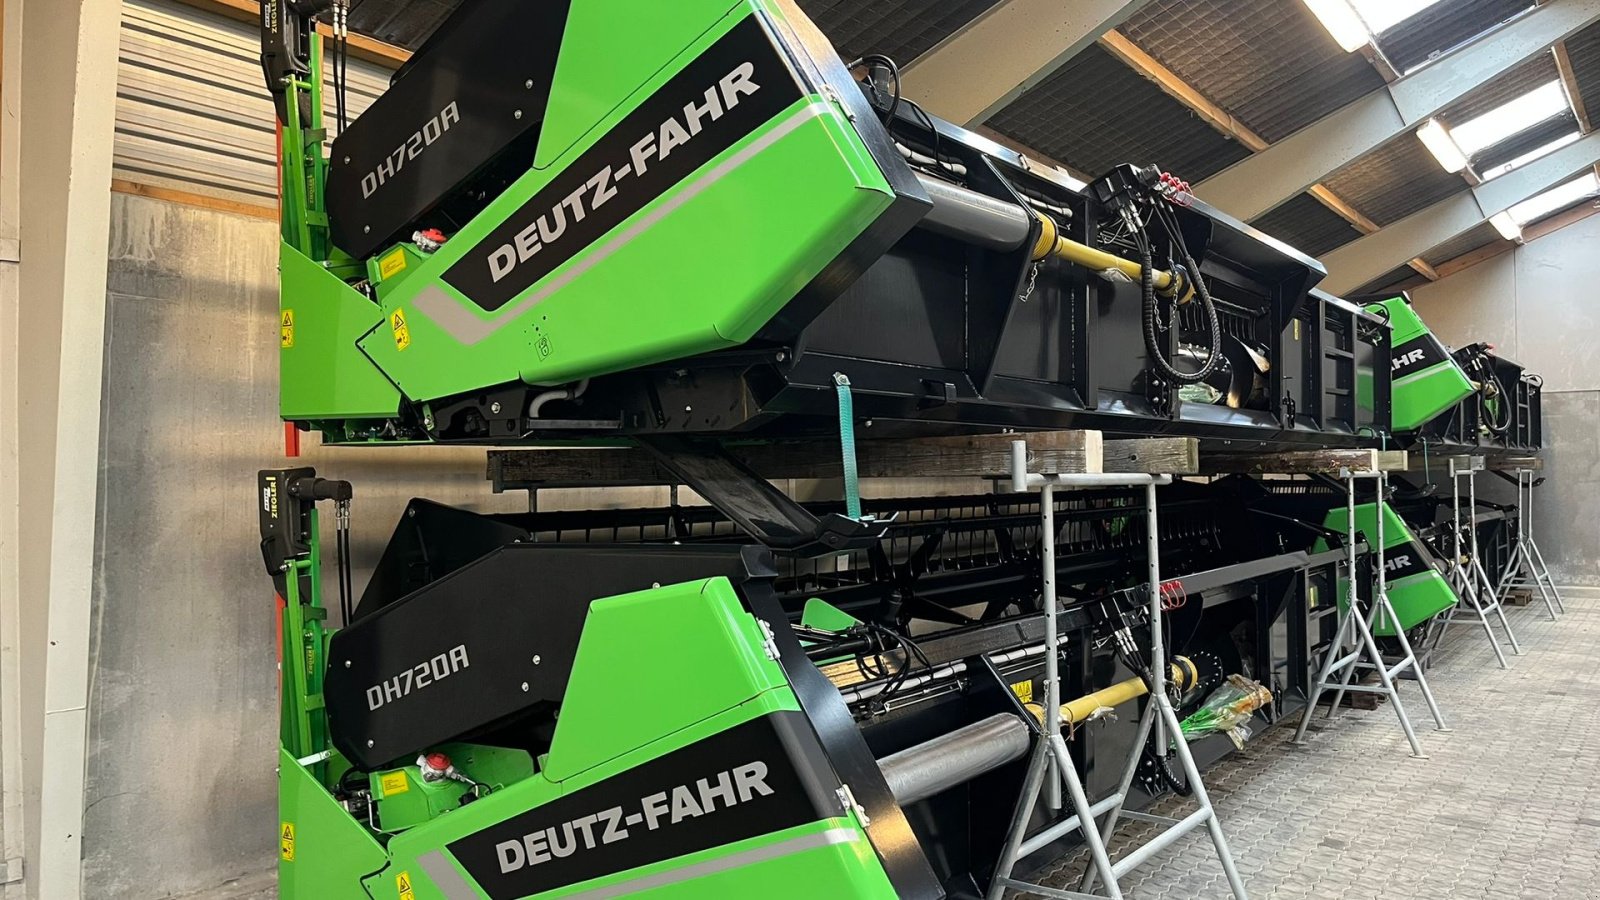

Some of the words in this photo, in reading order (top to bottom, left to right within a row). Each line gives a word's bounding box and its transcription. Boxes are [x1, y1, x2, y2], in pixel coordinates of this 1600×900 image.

[360, 100, 461, 200] DH720A
[487, 61, 761, 284] DEUTZ-FAHR
[270, 482, 278, 519] ZIEGLER
[366, 644, 470, 712] DH720A
[495, 760, 775, 874] DEUTZ-FAHR
